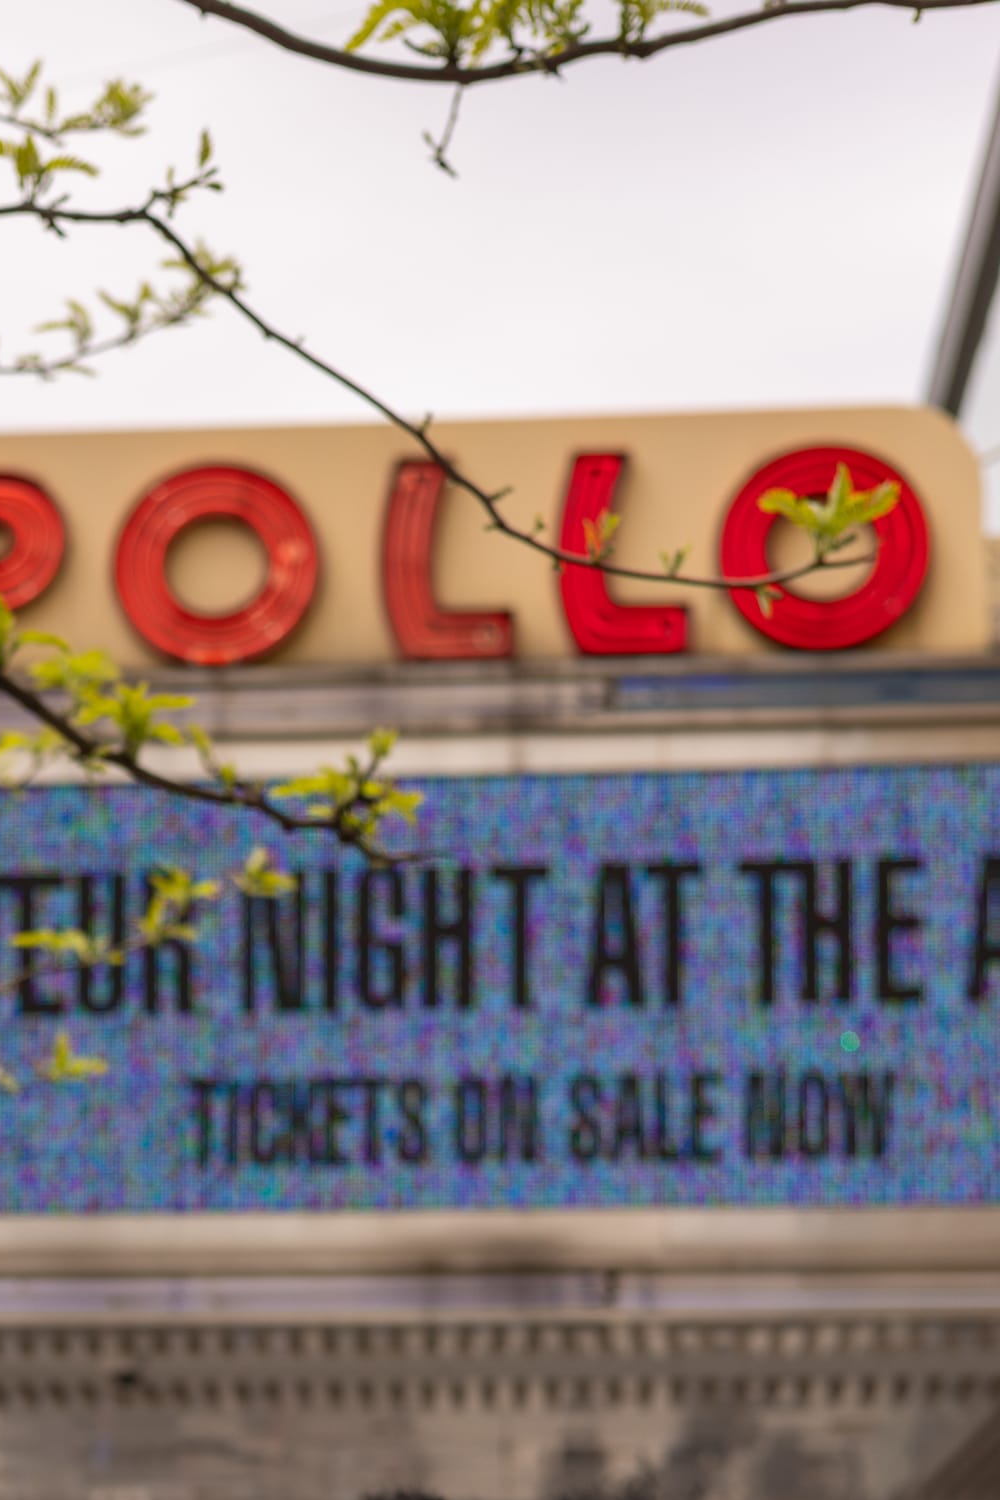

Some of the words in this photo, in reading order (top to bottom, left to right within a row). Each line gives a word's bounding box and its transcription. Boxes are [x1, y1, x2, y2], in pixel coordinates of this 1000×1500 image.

[242, 863, 550, 1010] NIGHT
[588, 861, 701, 1008] AT
[741, 856, 925, 1005] THE
[192, 1077, 427, 1166] TICKETS
[457, 1075, 537, 1164] ON
[569, 1073, 724, 1164] SALE
[744, 1069, 896, 1161] NOW
